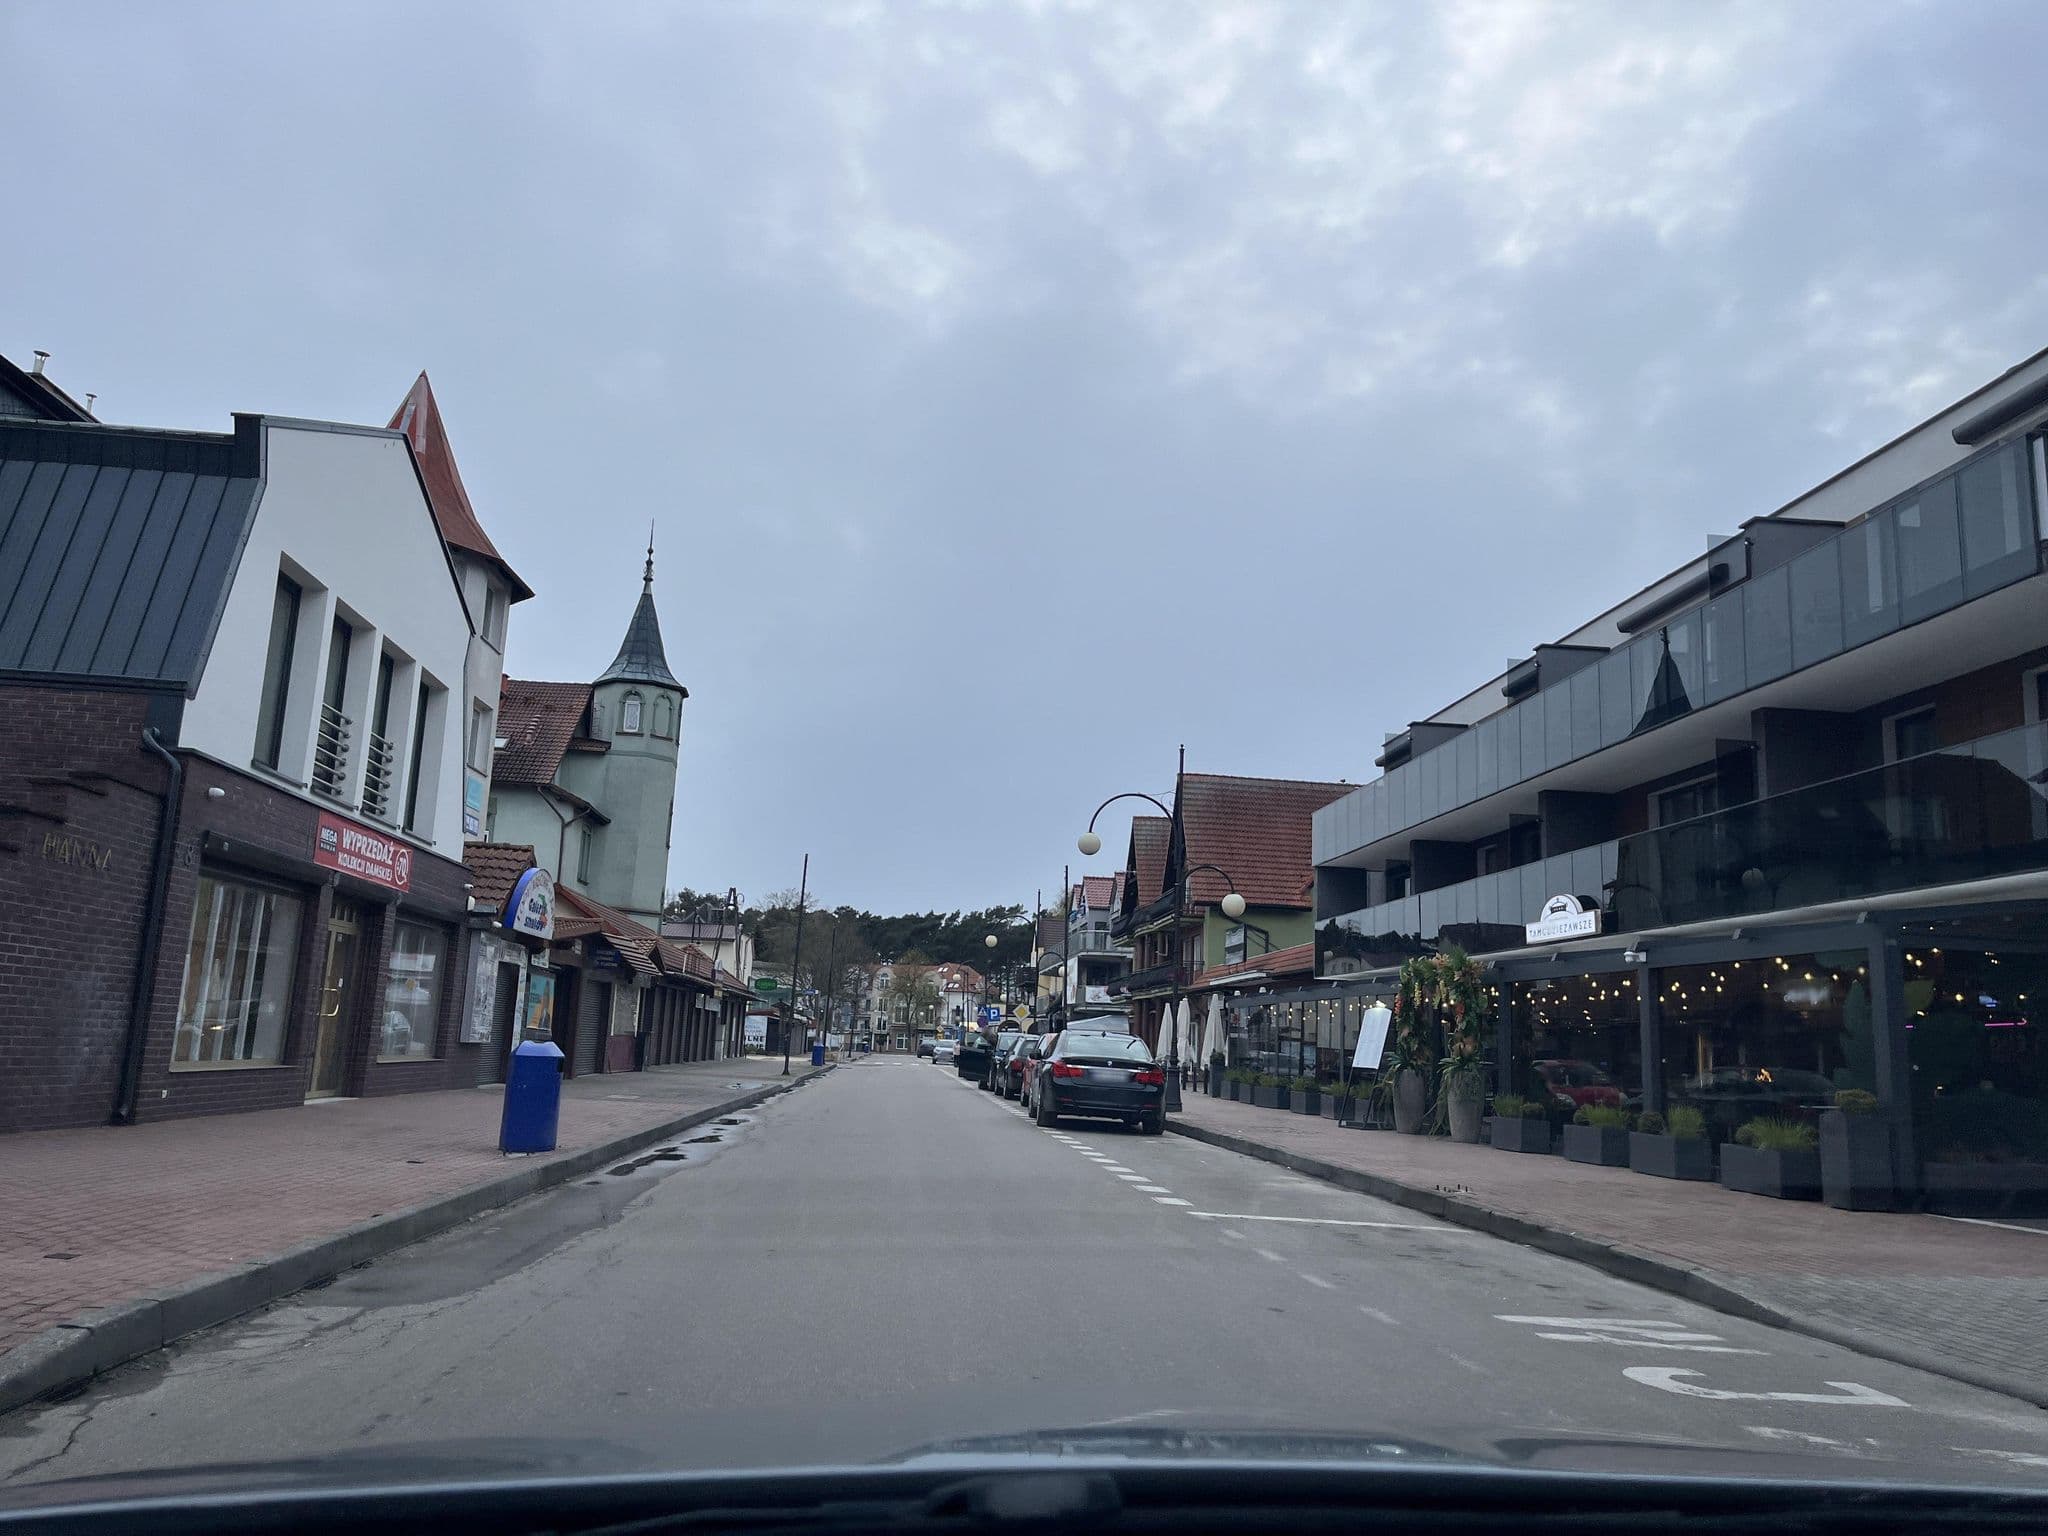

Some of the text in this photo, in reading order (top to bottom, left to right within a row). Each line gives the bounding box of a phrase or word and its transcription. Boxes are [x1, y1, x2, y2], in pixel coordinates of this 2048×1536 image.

[320, 827, 337, 843] MEGA
[343, 828, 395, 865] WYPRZEDAŻ
[365, 861, 393, 881] DAMSKIEJ
[990, 1009, 998, 1020] P
